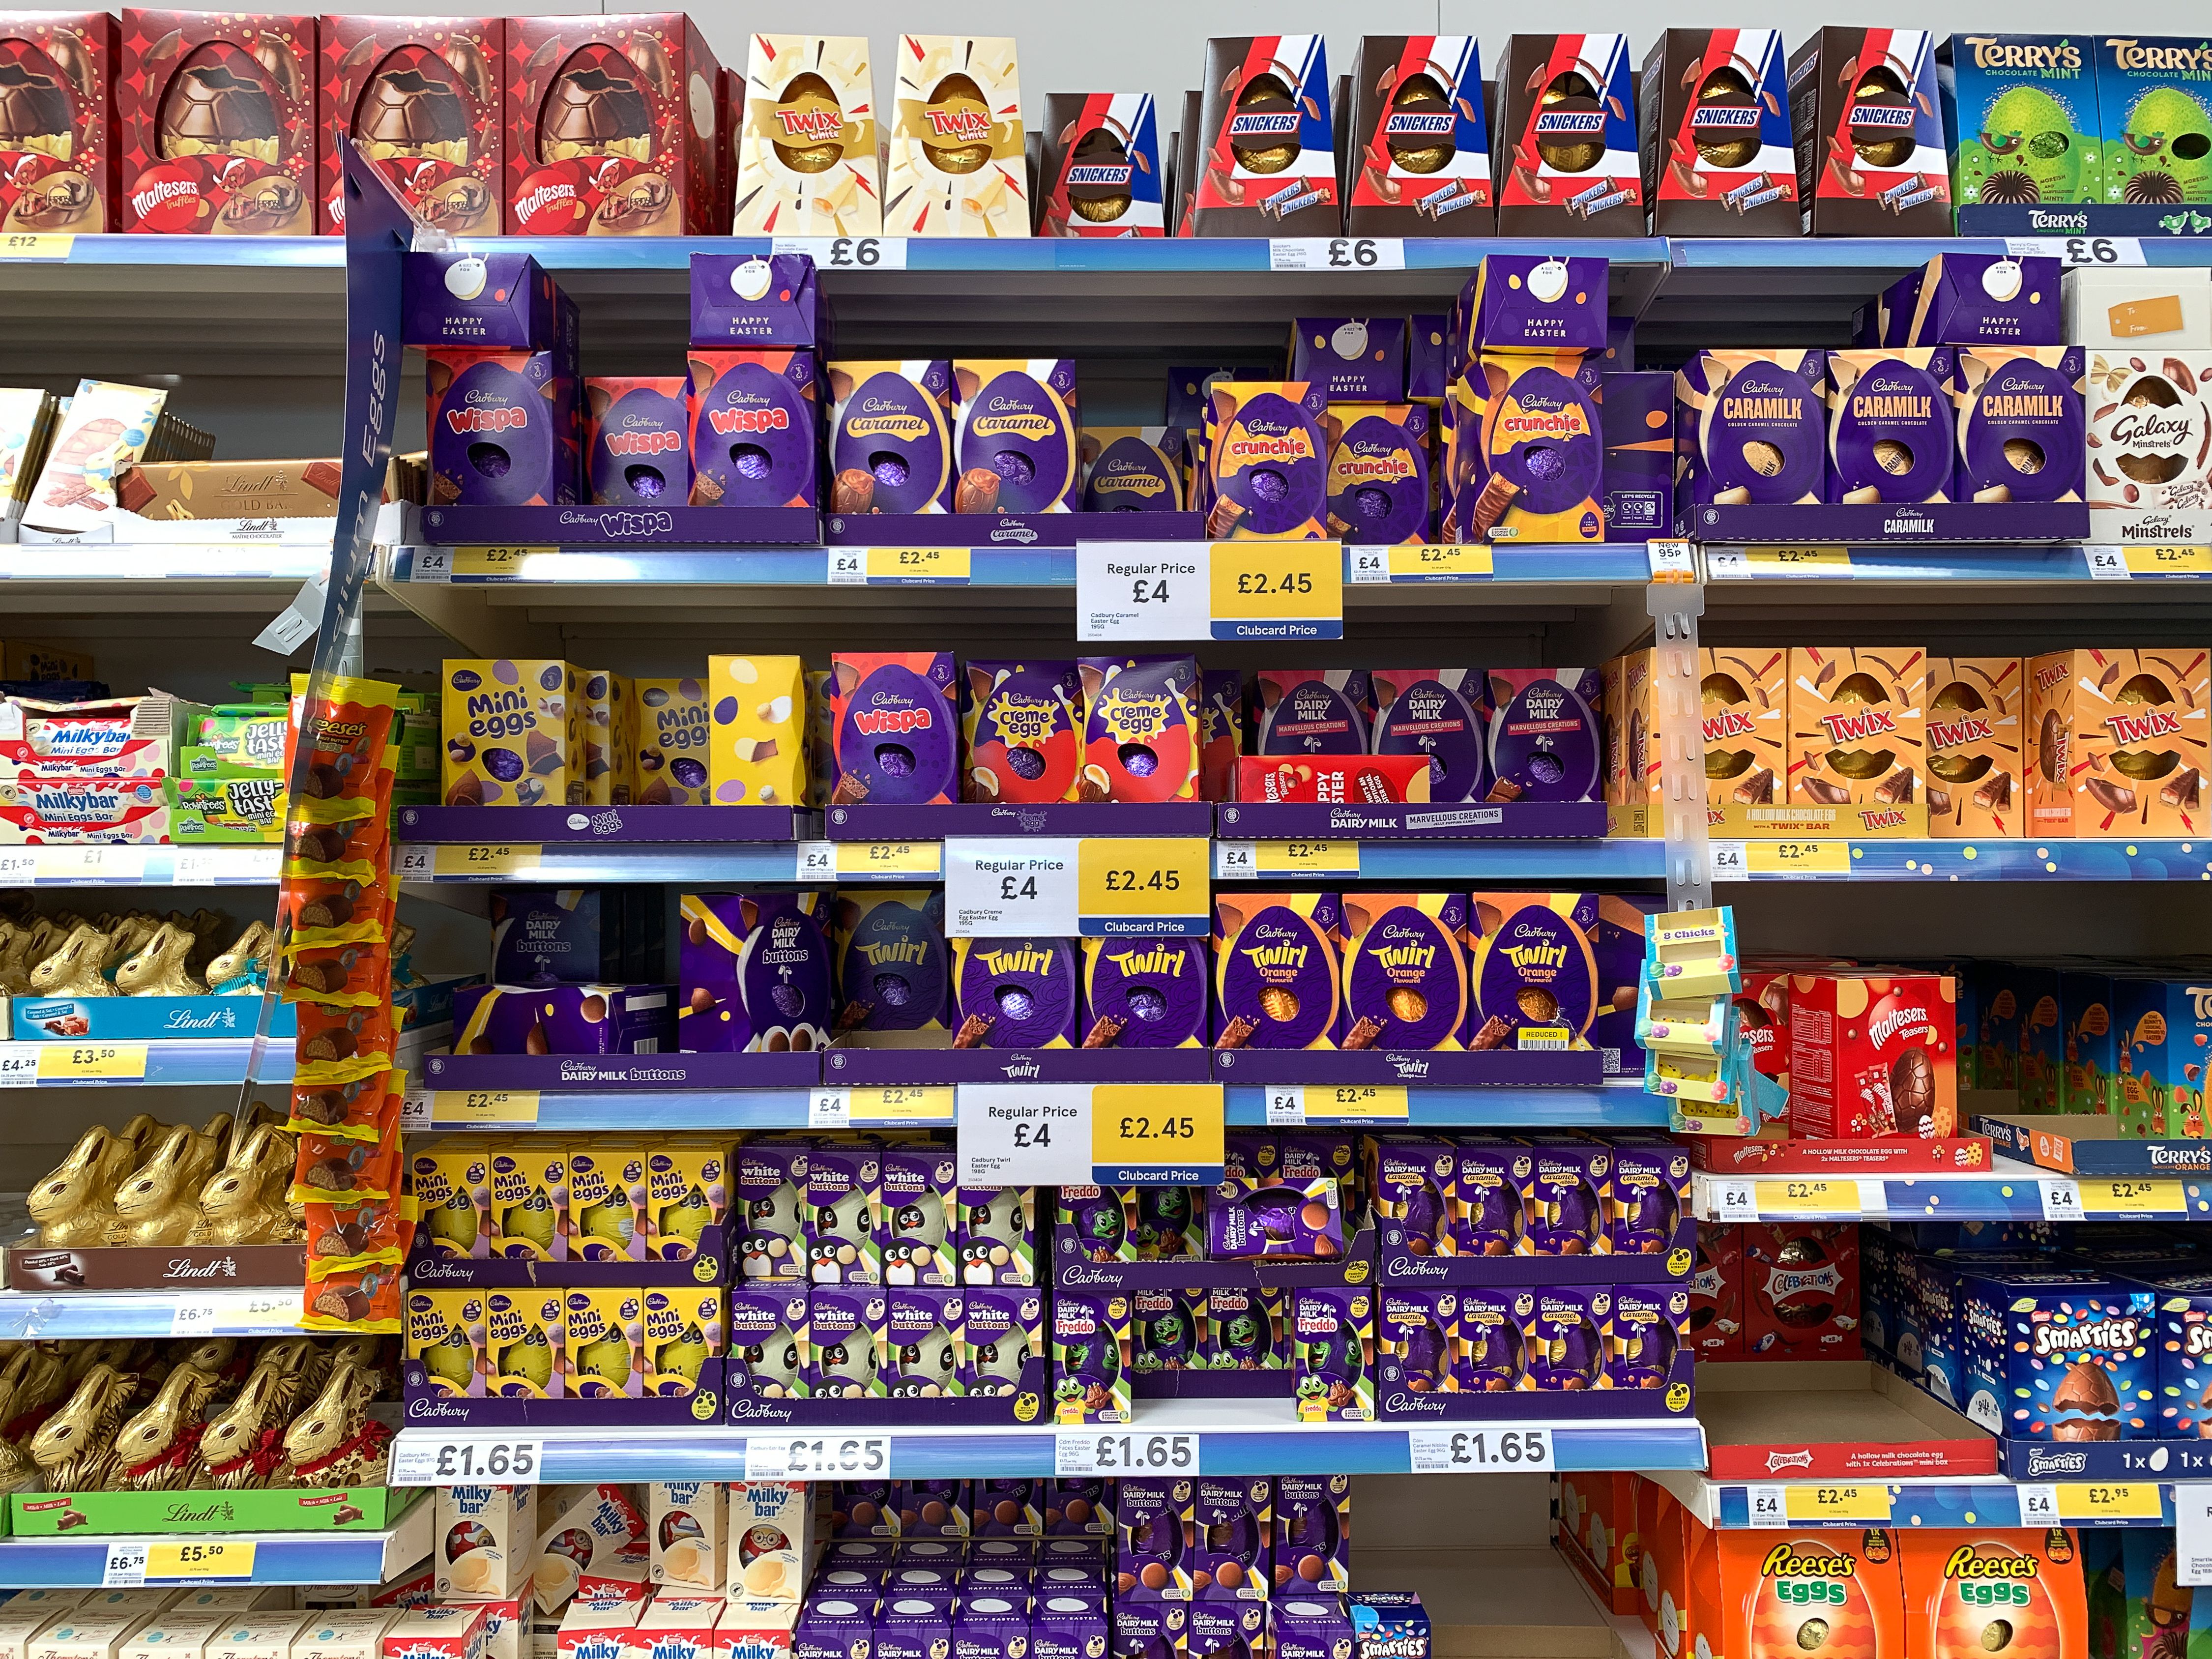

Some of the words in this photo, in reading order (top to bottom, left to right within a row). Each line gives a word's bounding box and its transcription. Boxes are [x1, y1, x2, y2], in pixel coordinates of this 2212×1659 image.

[1965, 37, 2082, 69] TERRY'S
[2041, 68, 2081, 80] MINT
[775, 108, 843, 136] Twix
[1695, 108, 1758, 126] SNICKERS
[809, 128, 843, 141] white
[1068, 166, 1130, 184] SNICKERS
[132, 180, 198, 220] Maltesers
[165, 195, 196, 211] Truffles
[1438, 193, 1472, 214] SNICKERS
[7, 236, 36, 247] £12
[830, 238, 880, 265] £6
[1329, 239, 1377, 266] £6
[2066, 238, 2118, 262] £6
[1527, 319, 1565, 327] HAPPY
[1524, 328, 1567, 338] EASTER
[1742, 380, 1784, 396] Cadbury
[362, 329, 387, 468] Eggs
[465, 390, 508, 406] Cadbury
[989, 396, 1034, 413] Cadbury
[1521, 394, 1563, 410] Cadbury
[1723, 398, 1802, 419] CARAMILK
[447, 406, 527, 434] Wispa
[976, 415, 1051, 431] Caramel
[1504, 414, 1580, 434] crunchie
[2111, 413, 2193, 447] Galaxy
[2132, 440, 2171, 449] Minstrels
[236, 520, 269, 531] Lindt
[560, 511, 598, 525] Cadbury
[601, 511, 672, 537] Wispa
[1359, 557, 1380, 569] £4
[1421, 549, 1460, 561] £2.45
[1107, 563, 1157, 577] Regular
[1161, 563, 1195, 574] Price
[1133, 580, 1169, 603] £4
[1238, 573, 1312, 594] £2.45
[1237, 625, 1286, 635] Clubcard
[1290, 626, 1317, 635] Price
[467, 686, 529, 718] Mini
[1110, 704, 1163, 721] creme
[468, 709, 537, 738] eggs
[1119, 717, 1153, 733] egg
[1822, 709, 1897, 745] Twix
[35, 790, 118, 812] Milkybar
[1330, 808, 1361, 819] Cadbury
[1410, 814, 1457, 823] MARVELLOUS
[1459, 810, 1499, 819] CREATIONS
[1746, 809, 1750, 821] A
[1751, 809, 1775, 821] HOLLOW
[1775, 809, 1790, 821] MILK
[1792, 809, 1824, 821] CHOCOLATE
[1825, 809, 1836, 821] EGG
[1331, 818, 1368, 828] DAIRY
[1369, 818, 1398, 828] MILK
[975, 860, 1025, 872] Regular
[1029, 860, 1064, 870] Price
[1001, 876, 1038, 900] £4
[1106, 870, 1180, 891] £2.45
[1105, 922, 1154, 932] Clubcard
[1158, 923, 1185, 931] Price
[1514, 923, 1557, 940] Cadbury
[1674, 928, 1716, 939] Chicks
[762, 950, 808, 963] buttons
[1499, 940, 1568, 969] Twirl
[1518, 967, 1557, 978] Orange
[163, 1009, 222, 1029] Lindt
[1869, 1007, 1927, 1051] Maltesers
[1898, 1024, 1928, 1040] Teasers
[1, 1058, 36, 1072] £4.25
[72, 1049, 116, 1065] £3.50
[560, 1060, 597, 1072] Cadbury
[561, 1070, 598, 1081] DAIRY
[599, 1071, 628, 1080] MILK
[631, 1069, 686, 1081] buttons
[2147, 1145, 2211, 1164] TERRY'S
[1388, 1257, 1449, 1280] Cadbury
[178, 1308, 212, 1321] £6.75
[891, 1310, 932, 1321] white
[891, 1320, 932, 1330] buttons
[1298, 1319, 1337, 1332] Freddo
[2036, 1322, 2136, 1350] SMARTIES
[1096, 1436, 1191, 1467] £1.65
[452, 1485, 491, 1504] Milky
[2089, 1488, 2129, 1504] £2.95
[459, 1500, 484, 1515] bar
[180, 1546, 223, 1562] £5.50
[1762, 1543, 1855, 1577] Reese's
[1776, 1580, 1847, 1604] Eggs
